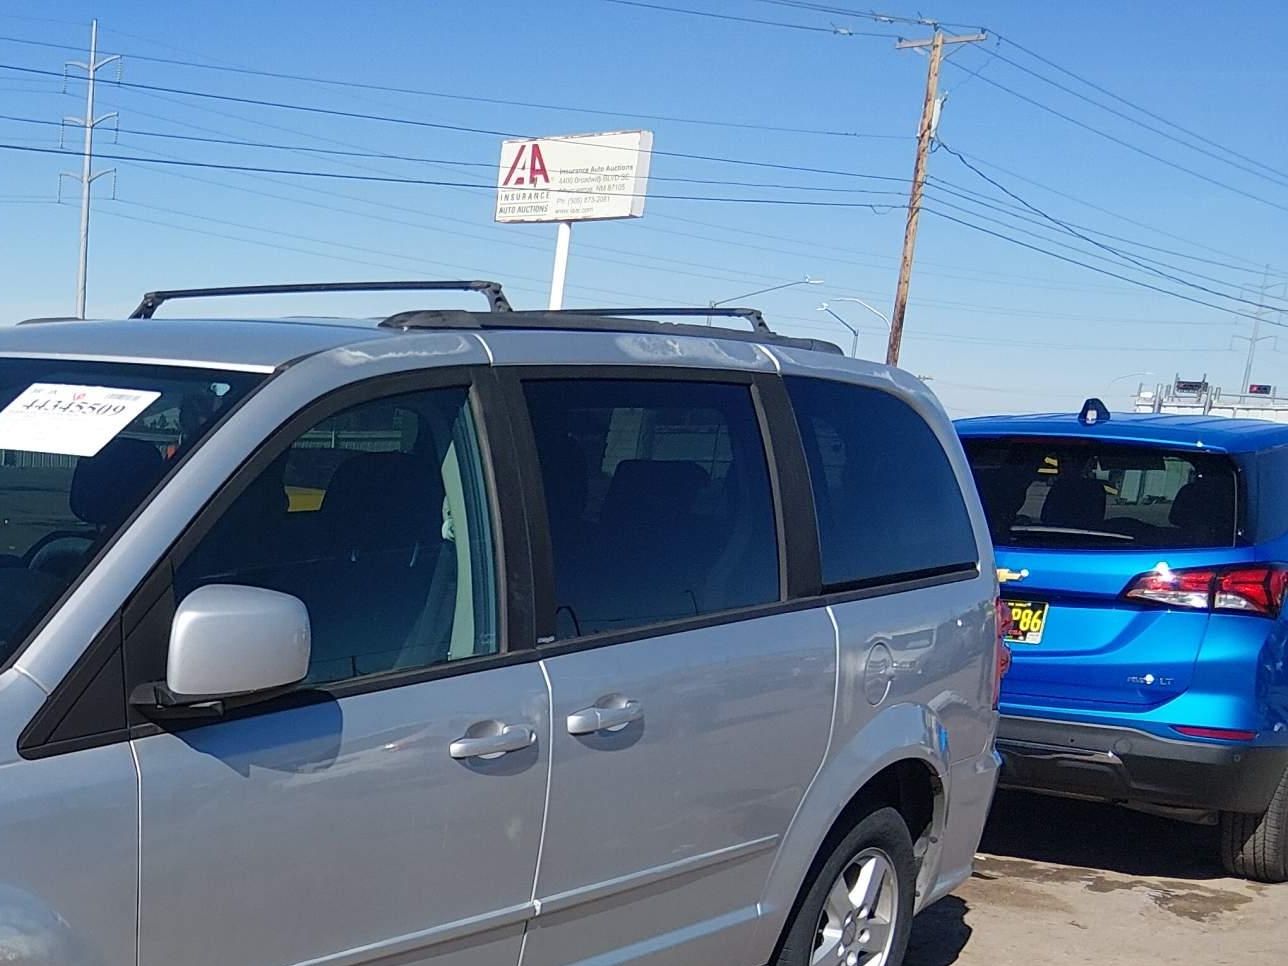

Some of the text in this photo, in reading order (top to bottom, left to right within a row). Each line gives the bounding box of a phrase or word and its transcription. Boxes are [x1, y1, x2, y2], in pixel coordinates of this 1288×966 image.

[559, 164, 633, 175] Insurance Auto Auctions
[500, 192, 550, 202] INSURANCE
[499, 204, 549, 215] AUTO AUCTIONS
